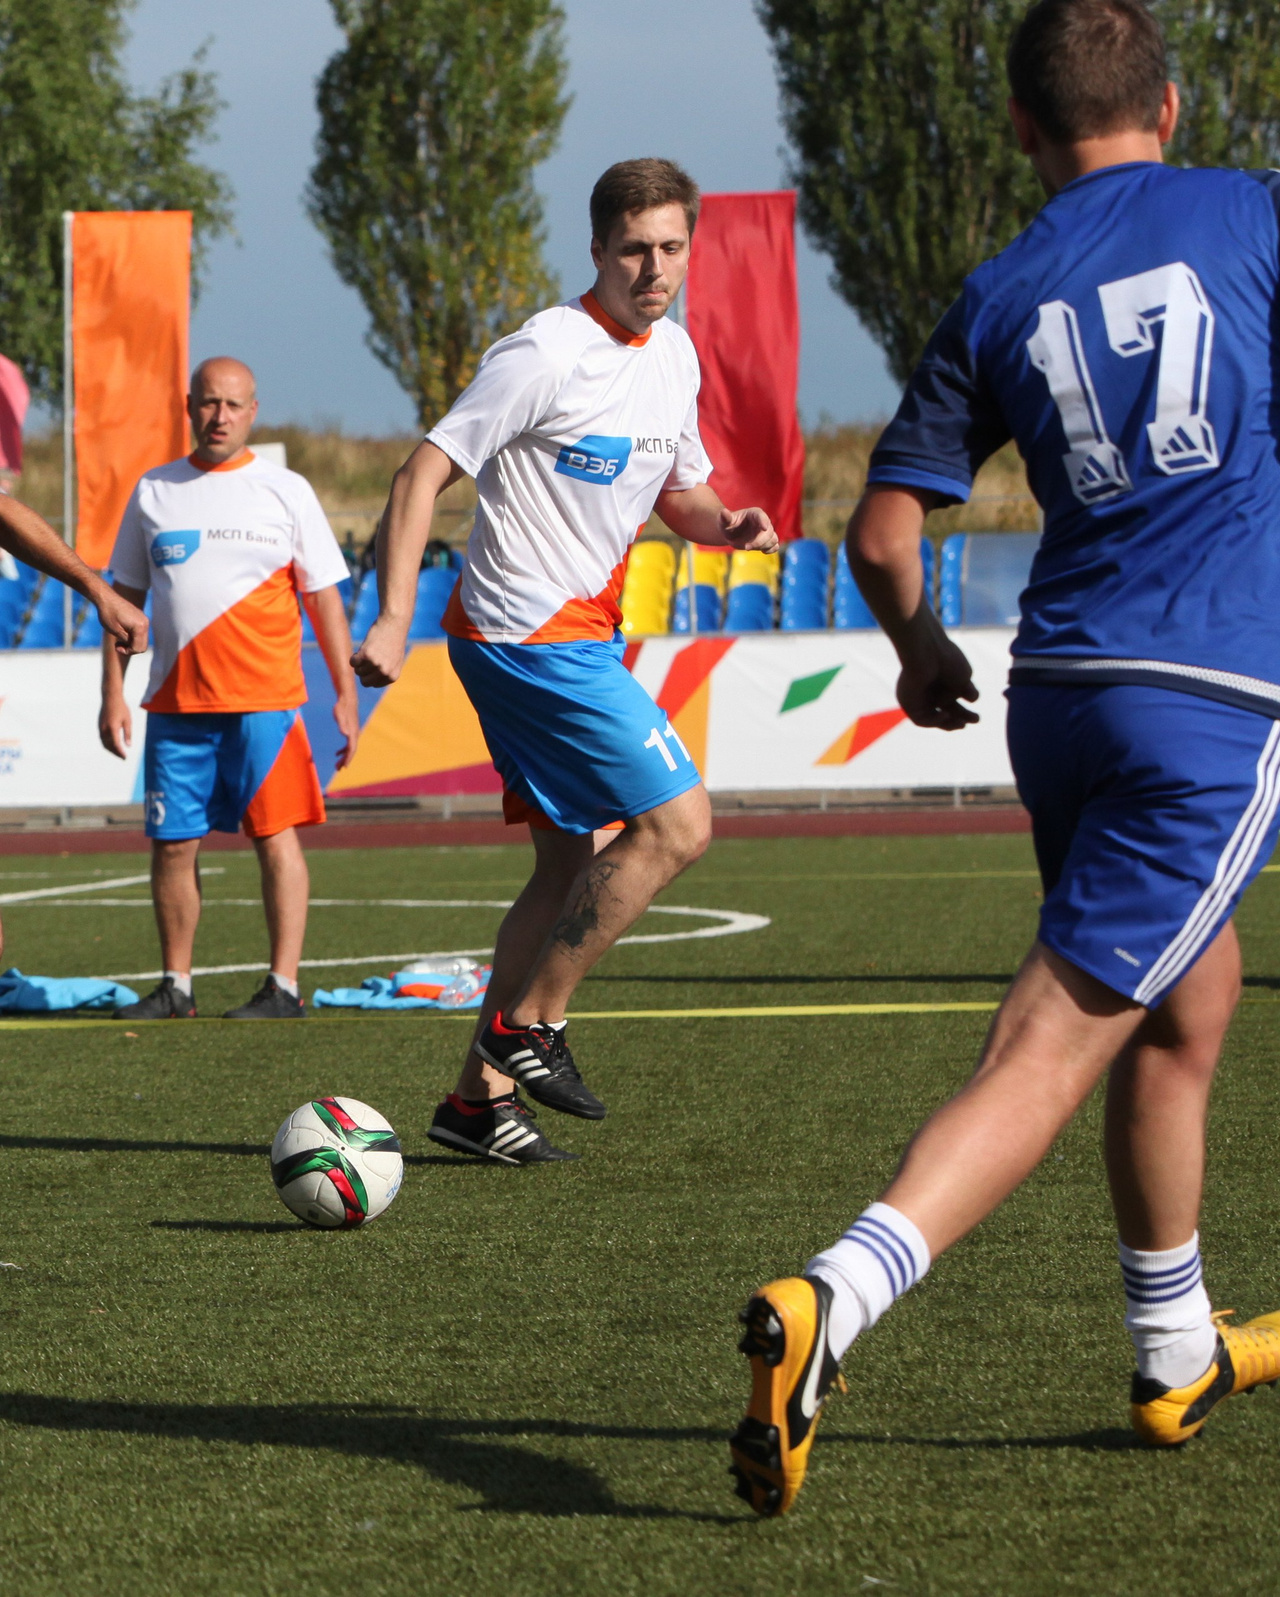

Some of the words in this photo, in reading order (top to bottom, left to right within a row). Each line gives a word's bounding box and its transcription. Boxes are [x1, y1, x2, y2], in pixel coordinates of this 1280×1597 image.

[1026, 261, 1220, 505] 17
[634, 437, 664, 454] МСП
[567, 452, 620, 477] ВЭБ
[207, 528, 242, 541] МСП
[246, 531, 280, 547] Банк
[643, 719, 692, 772] 11
